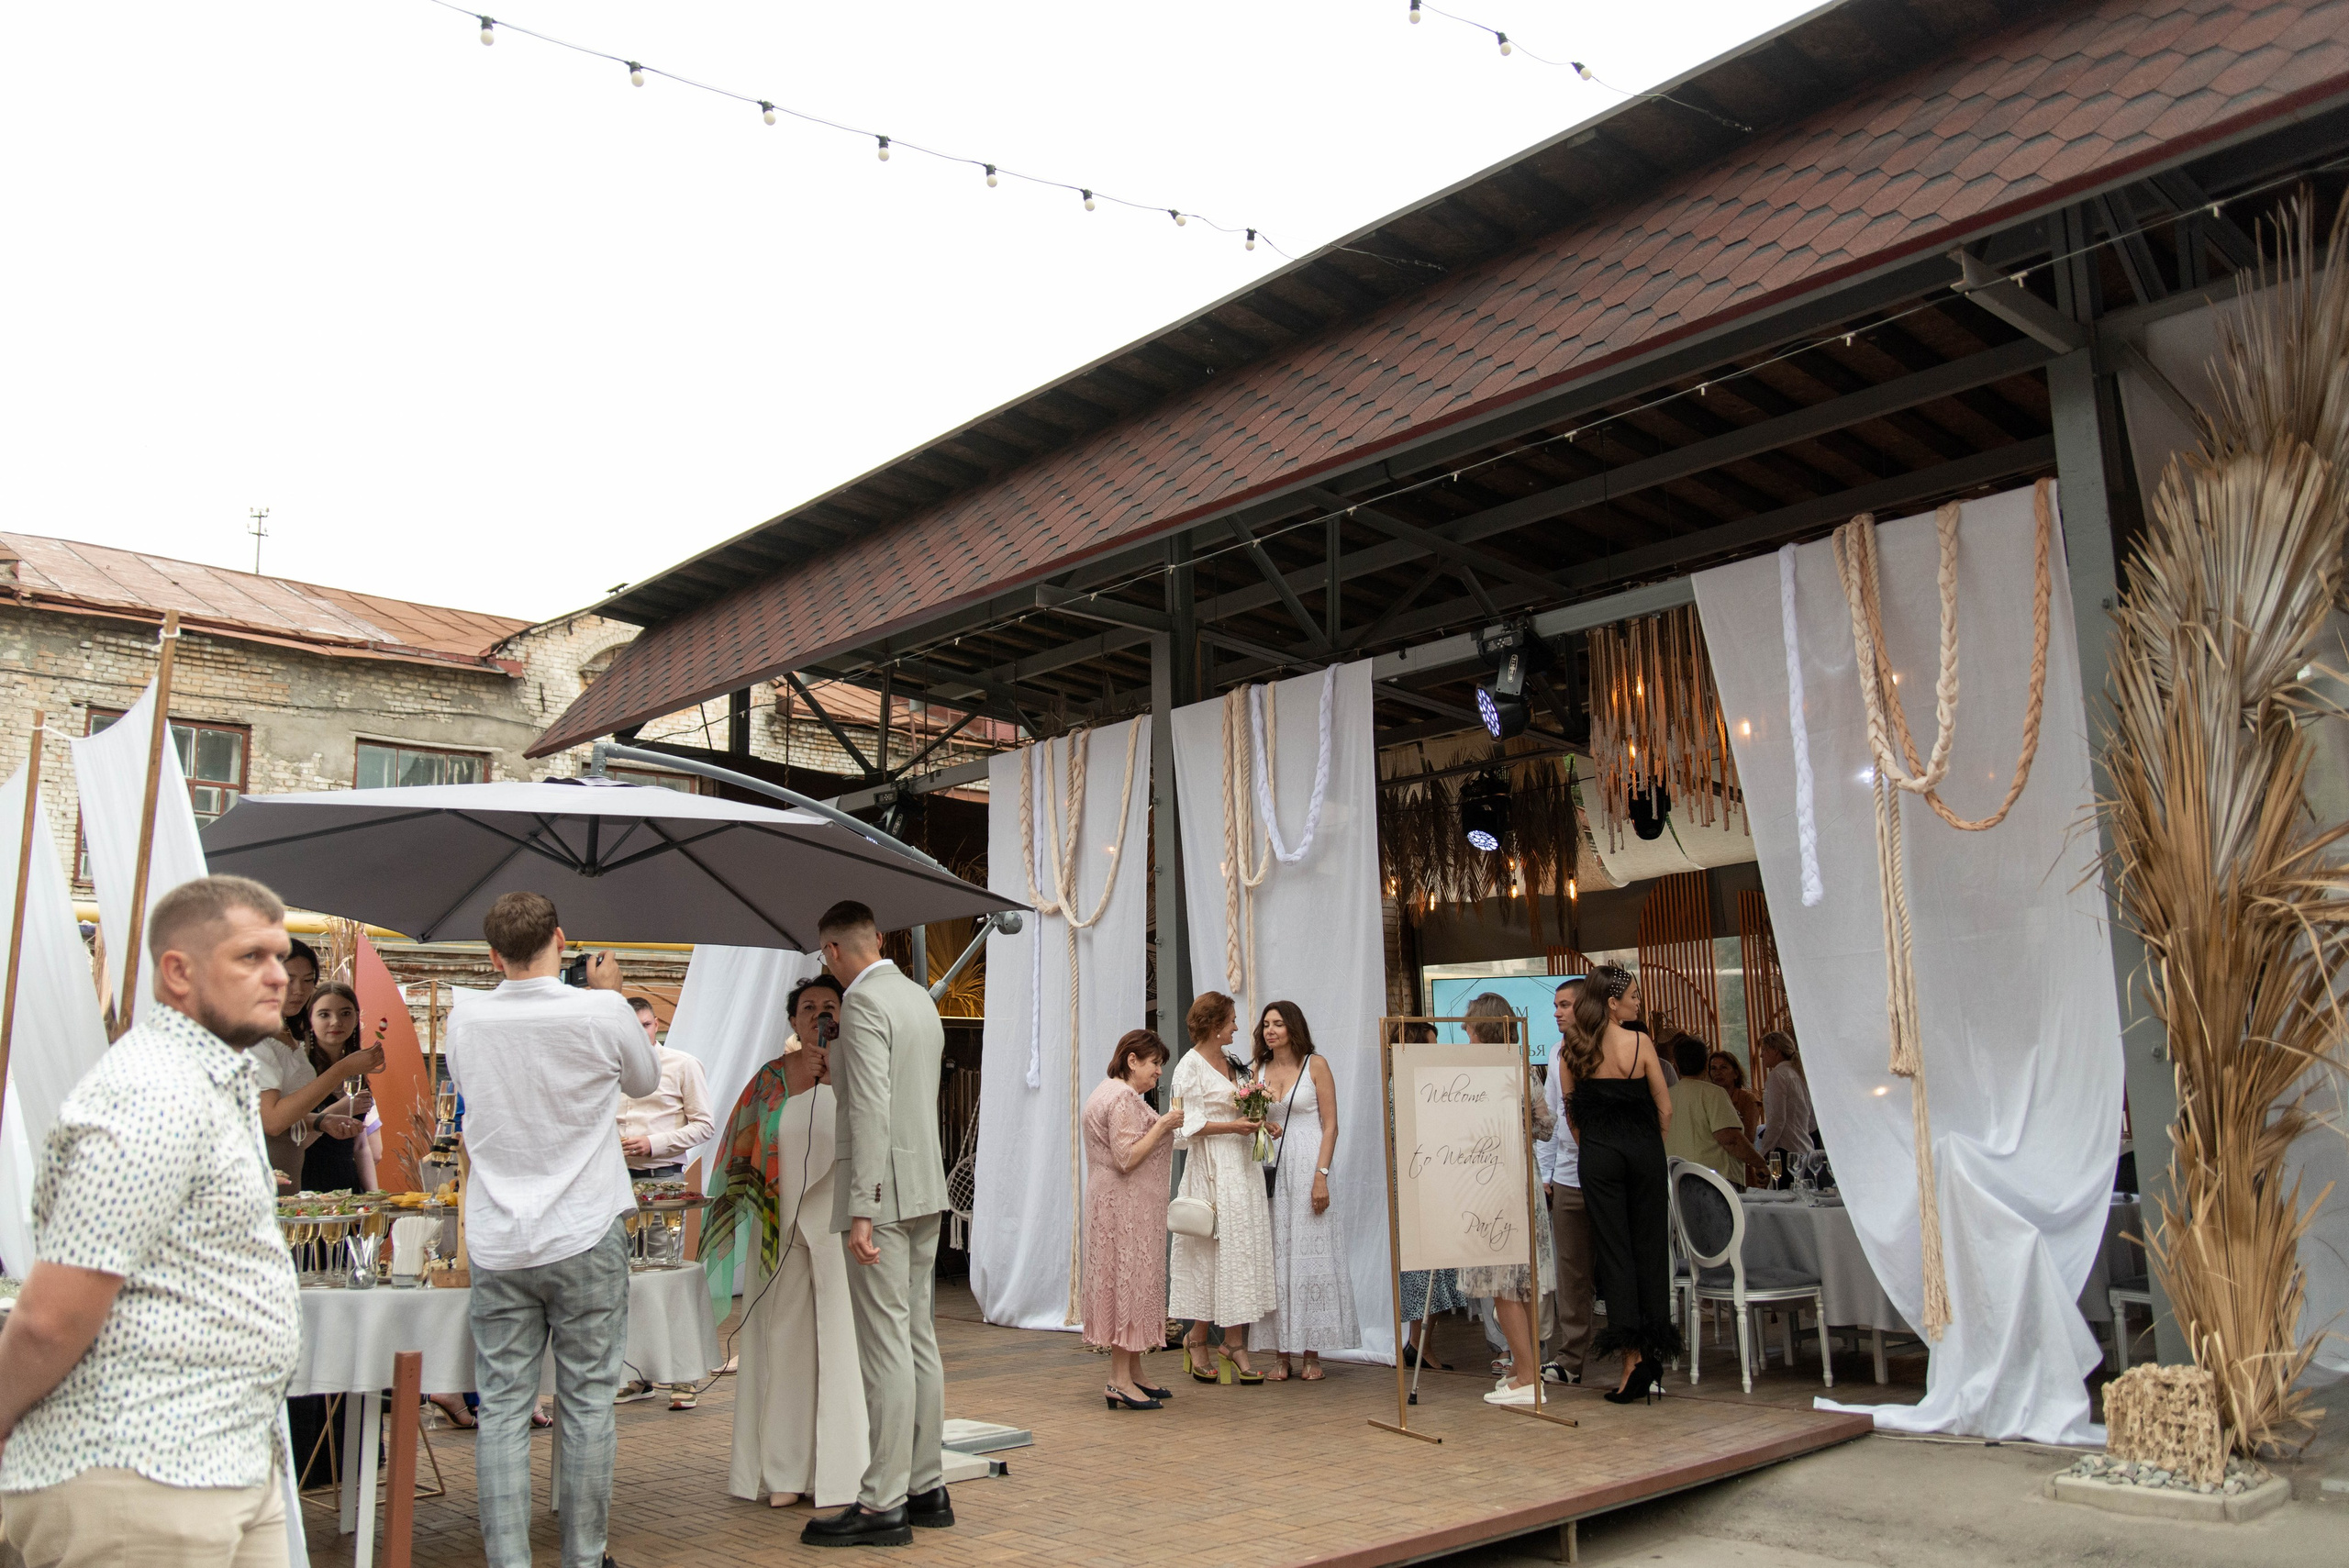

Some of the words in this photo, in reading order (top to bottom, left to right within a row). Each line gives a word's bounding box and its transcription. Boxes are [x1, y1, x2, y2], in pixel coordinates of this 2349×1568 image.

[1420, 1073, 1489, 1103] Welcome
[1408, 1143, 1431, 1179] to
[1436, 1135, 1505, 1184] Wedding
[1461, 1208, 1519, 1251] Party
